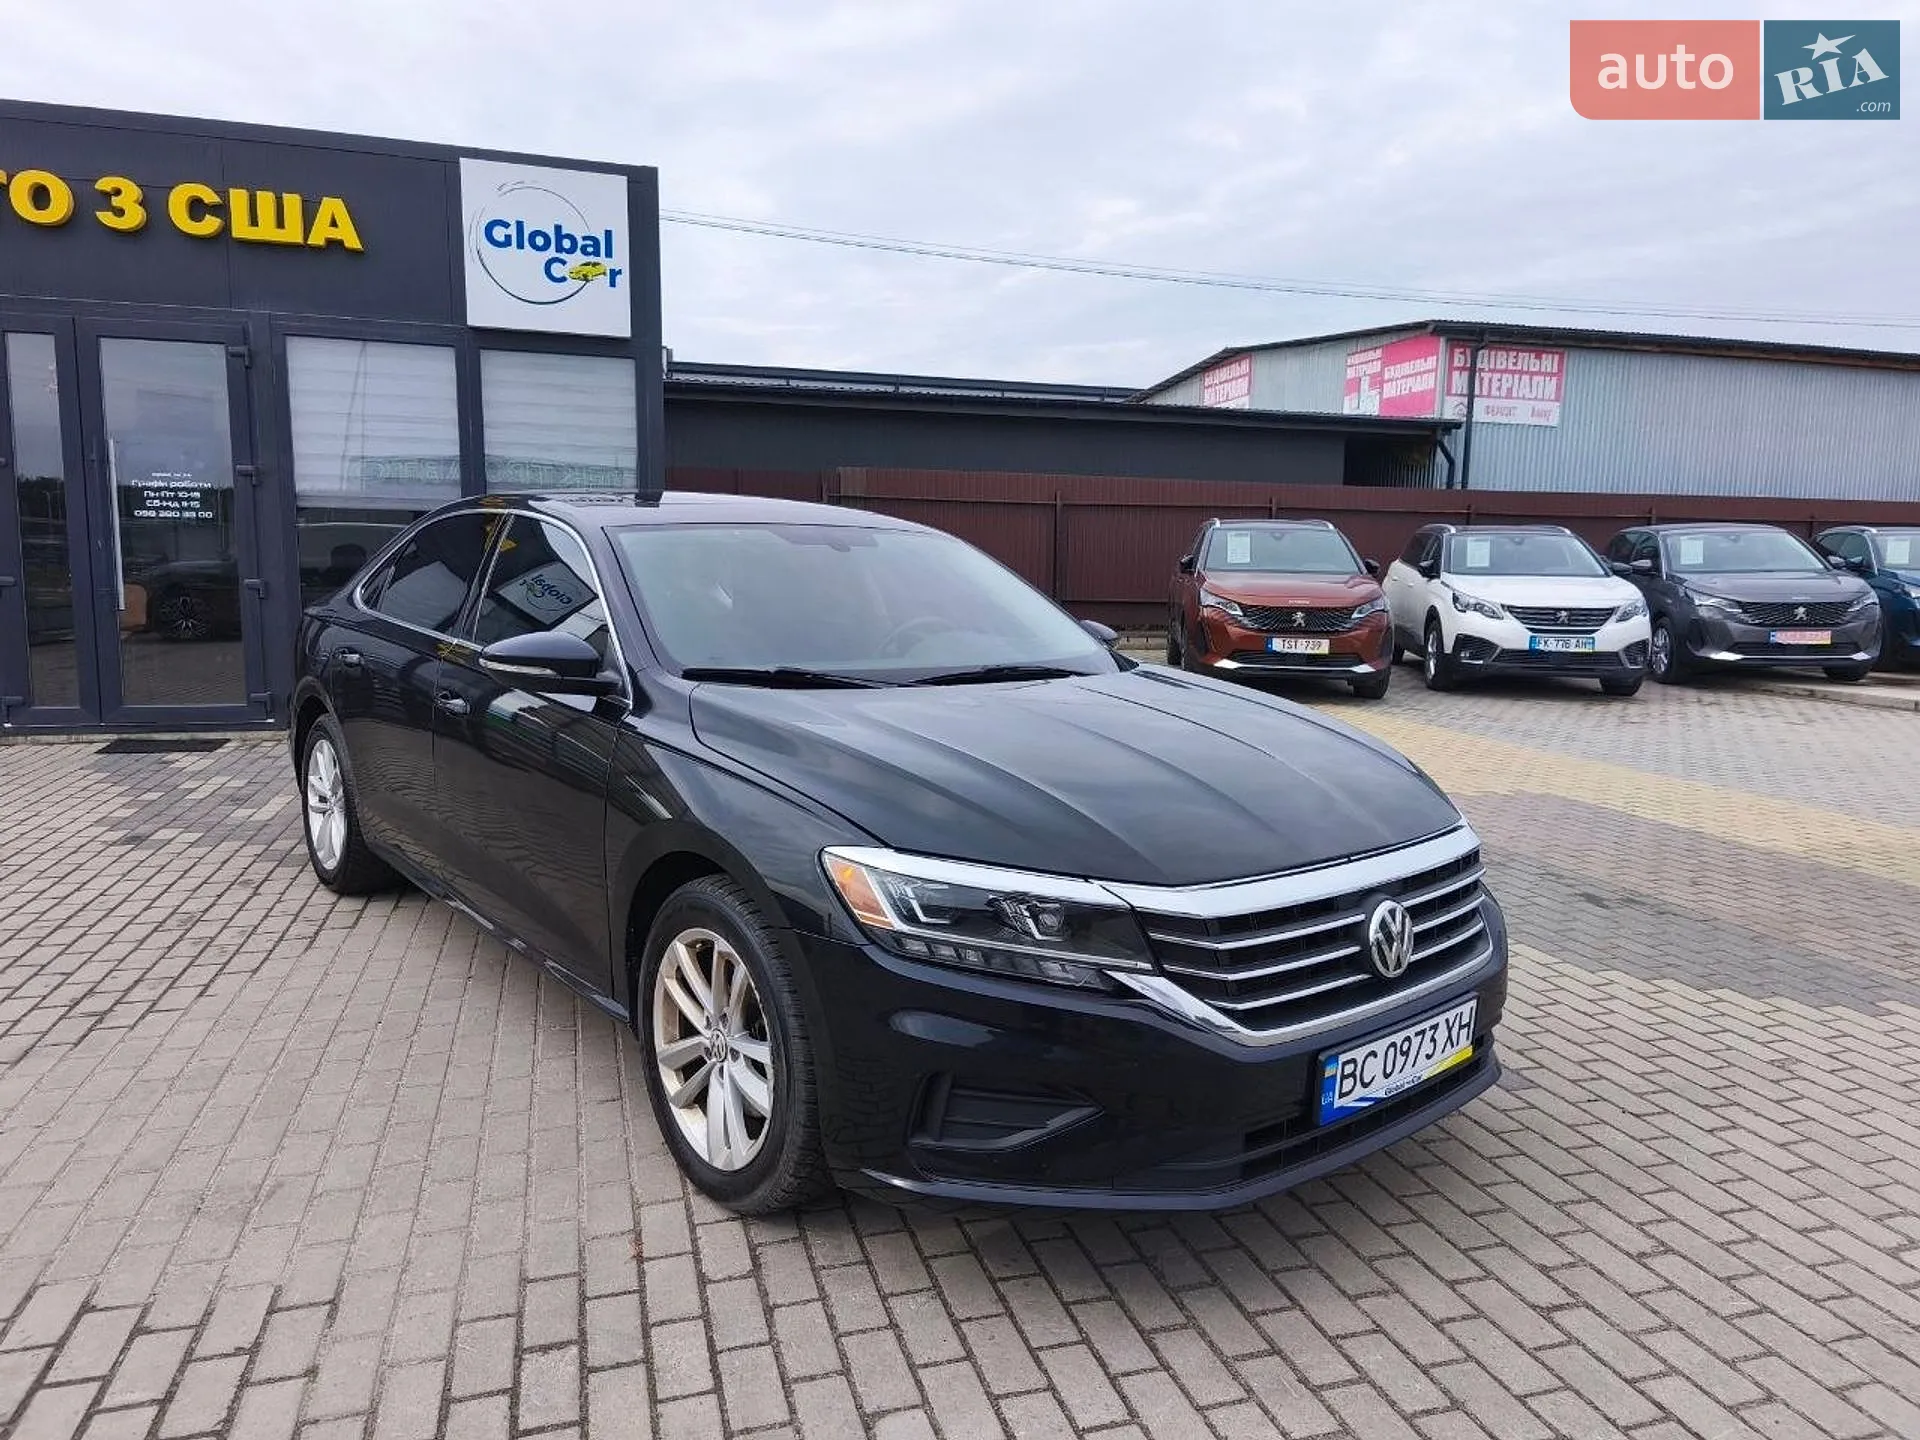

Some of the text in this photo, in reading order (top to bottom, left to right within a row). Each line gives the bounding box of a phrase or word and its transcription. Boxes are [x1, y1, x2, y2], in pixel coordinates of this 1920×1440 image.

[0, 168, 74, 227] О
[168, 181, 365, 254] США
[484, 218, 613, 259] Global
[544, 256, 622, 288] Cr
[169, 480, 211, 489] роботи
[1338, 1006, 1474, 1099] BC 0973 XH
